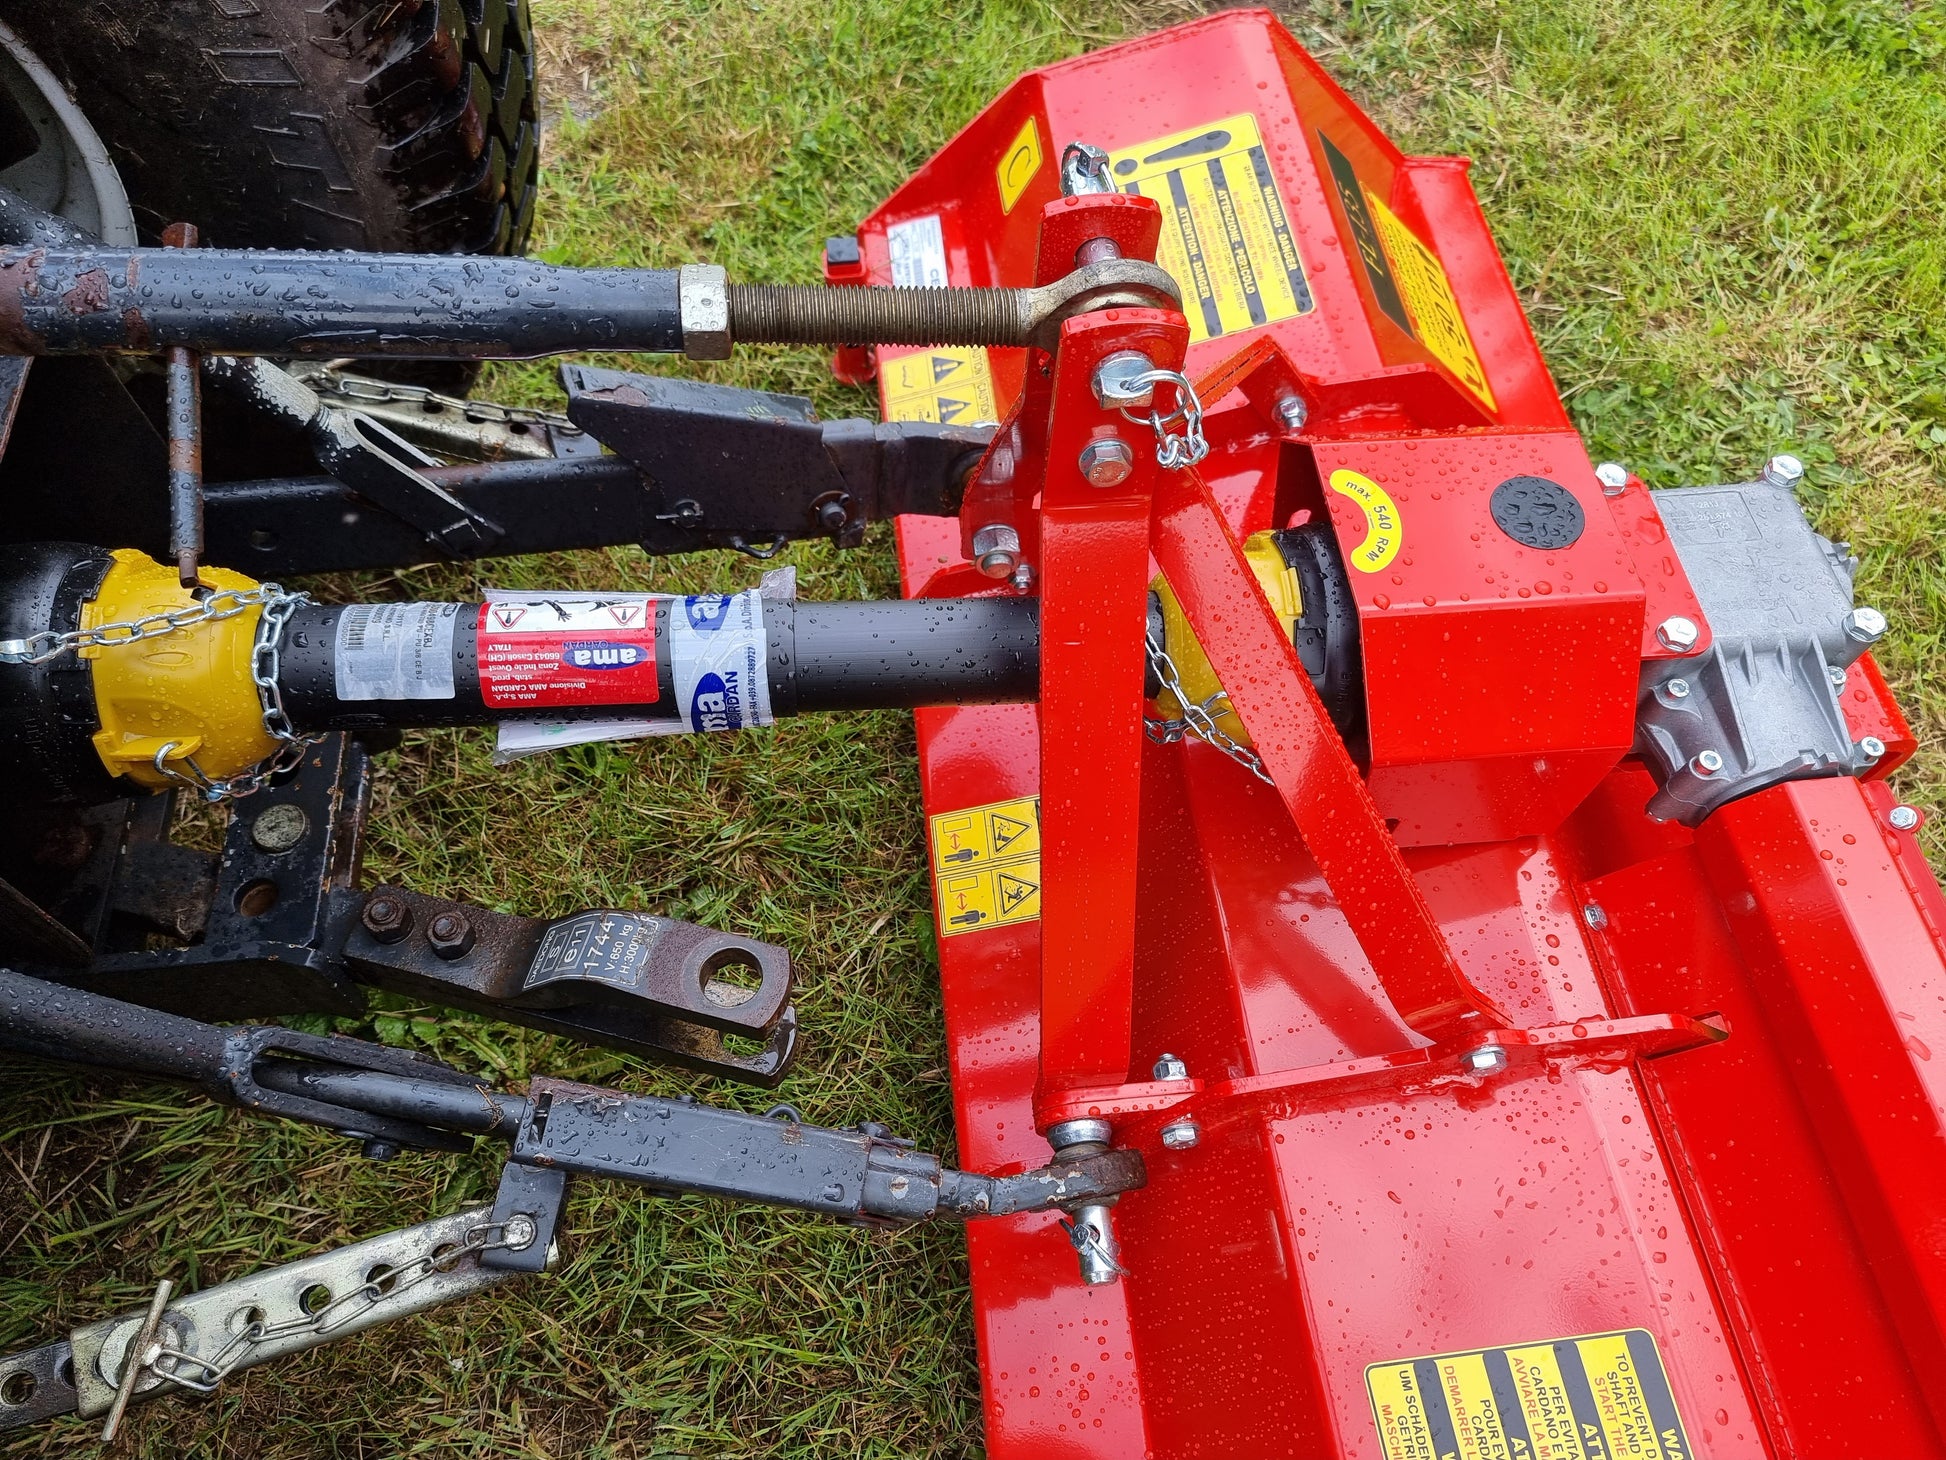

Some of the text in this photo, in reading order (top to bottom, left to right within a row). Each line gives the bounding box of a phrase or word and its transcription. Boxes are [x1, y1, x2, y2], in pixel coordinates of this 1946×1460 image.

[1216, 188, 1241, 242] ATTENZIONE
[1234, 248, 1256, 295] PERICOLO
[1240, 216, 1255, 249] CONTINUE
[1262, 185, 1283, 228] WARNING
[1277, 232, 1298, 271] DANGER
[1177, 206, 1200, 255] ATTENTION
[1192, 260, 1212, 299] DANGER
[1250, 250, 1258, 261] TO
[1253, 261, 1264, 280] TURN
[1271, 255, 1282, 275] WHEEL
[1278, 279, 1290, 300] DEVICE
[1435, 302, 1462, 347] 50
[970, 347, 983, 375] AUTION
[978, 382, 989, 417] CAUTION
[1346, 481, 1392, 562] max. 540 RPM
[416, 639, 422, 647] PU
[487, 653, 505, 661] (CH)
[562, 640, 607, 649] CARDAN
[574, 647, 636, 665] ama
[700, 692, 729, 730] ma
[564, 929, 586, 962] e11
[583, 920, 615, 969] 1744
[604, 924, 633, 970] V:650 kg
[1398, 1368, 1412, 1391] UM
[1443, 1365, 1474, 1447] DEMARRER
[1480, 1399, 1500, 1440] POUR
[1513, 1358, 1552, 1460] AVVIARE LA M
[1530, 1366, 1559, 1439] CARDANO
[1552, 1444, 1563, 1453] E
[1549, 1386, 1566, 1416] PER
[1560, 1420, 1580, 1460] EVITA
[1595, 1377, 1628, 1457] START THE
[1606, 1371, 1640, 1454] SHAFT AND
[1616, 1353, 1657, 1459] TO PREVENT D
[1381, 1404, 1403, 1460] MASCHI
[1397, 1415, 1417, 1459] GETRI
[1582, 1424, 1606, 1460] ATT
[1661, 1428, 1684, 1460] WA
